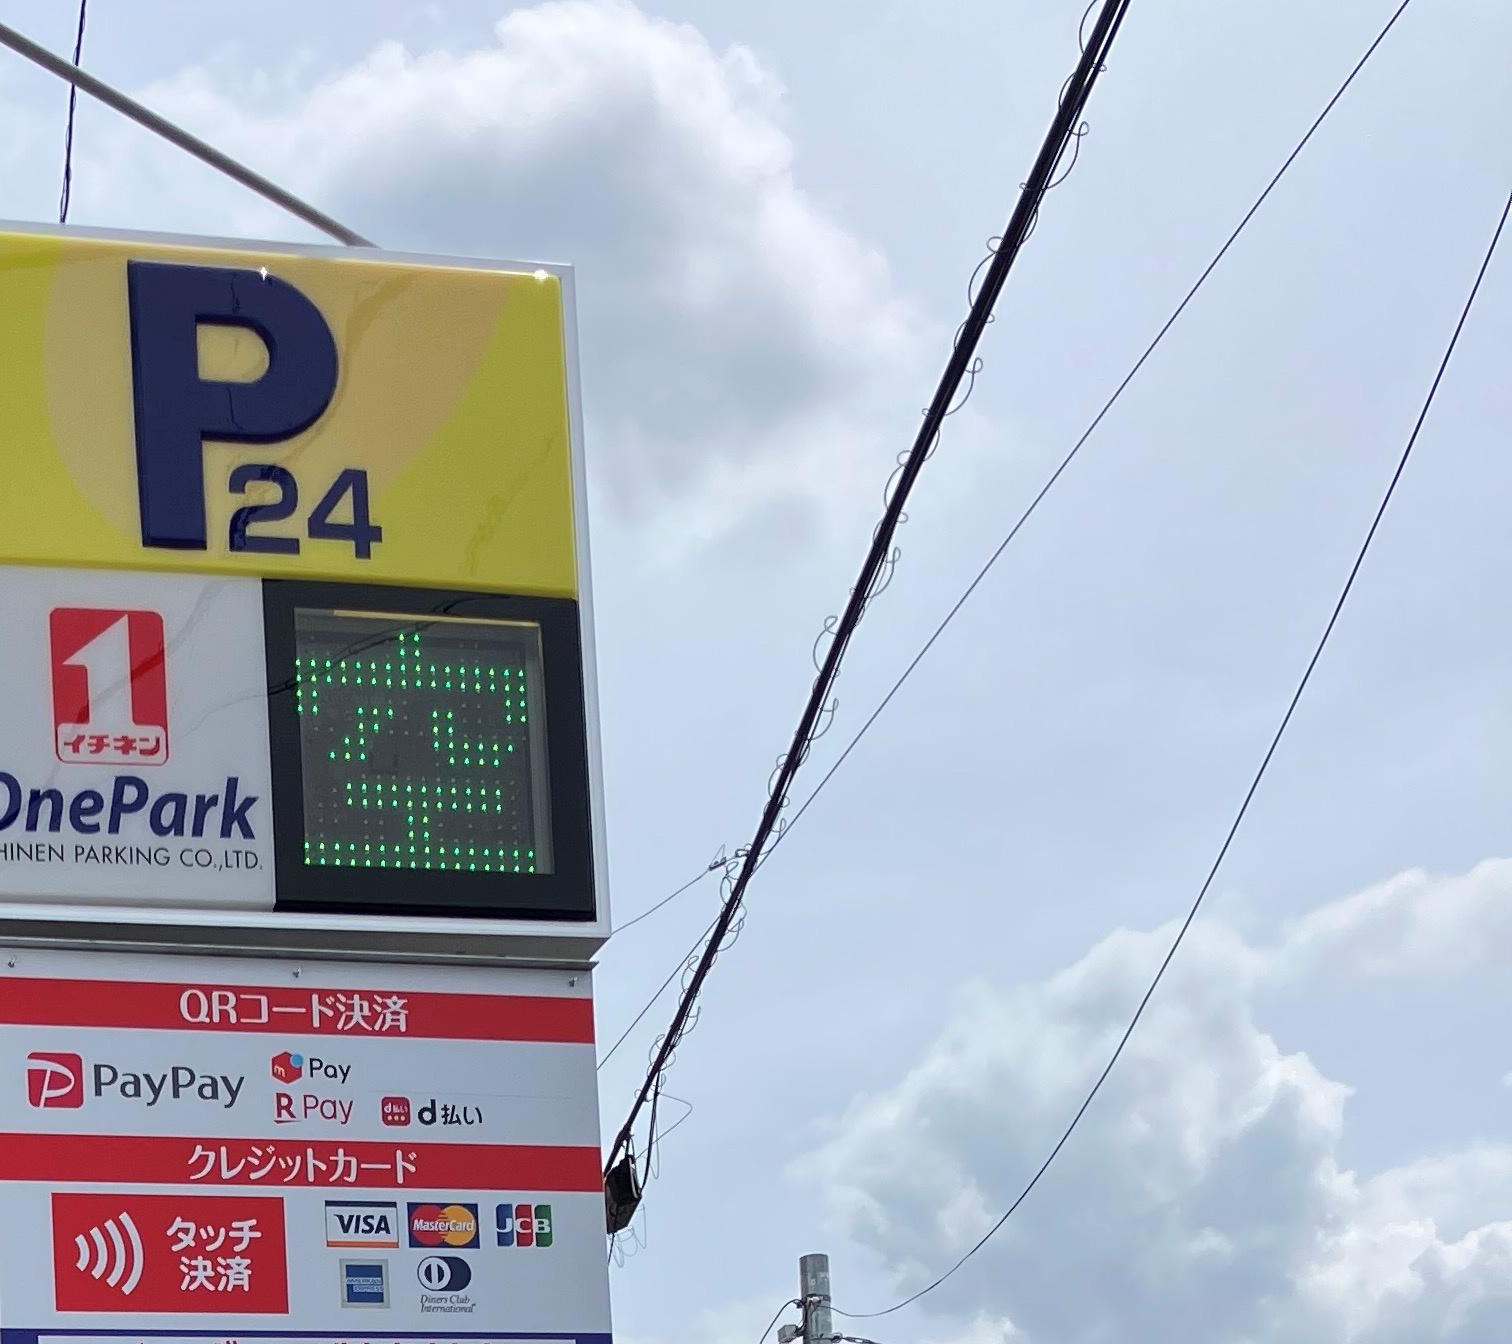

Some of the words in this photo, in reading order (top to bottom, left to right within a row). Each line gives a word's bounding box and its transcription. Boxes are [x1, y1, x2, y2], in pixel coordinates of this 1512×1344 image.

[127, 260, 339, 550] P
[226, 463, 383, 560] 24
[63, 734, 161, 756] イチネン
[74, 845, 171, 867] PARKING
[179, 989, 410, 1034] QRコード決済
[309, 1057, 352, 1084] Pay
[93, 1062, 245, 1109] PayPay
[303, 1094, 354, 1125] Pay
[417, 1098, 484, 1126] d払い
[187, 1144, 418, 1184] クレジットカード
[166, 1216, 262, 1254] タッチ
[334, 1213, 392, 1235] VISA
[412, 1219, 476, 1233] MasterCard
[495, 1217, 553, 1235] JCB
[179, 1256, 253, 1294] 決済
[420, 1294, 447, 1305] Diners
[449, 1294, 471, 1305] Club
